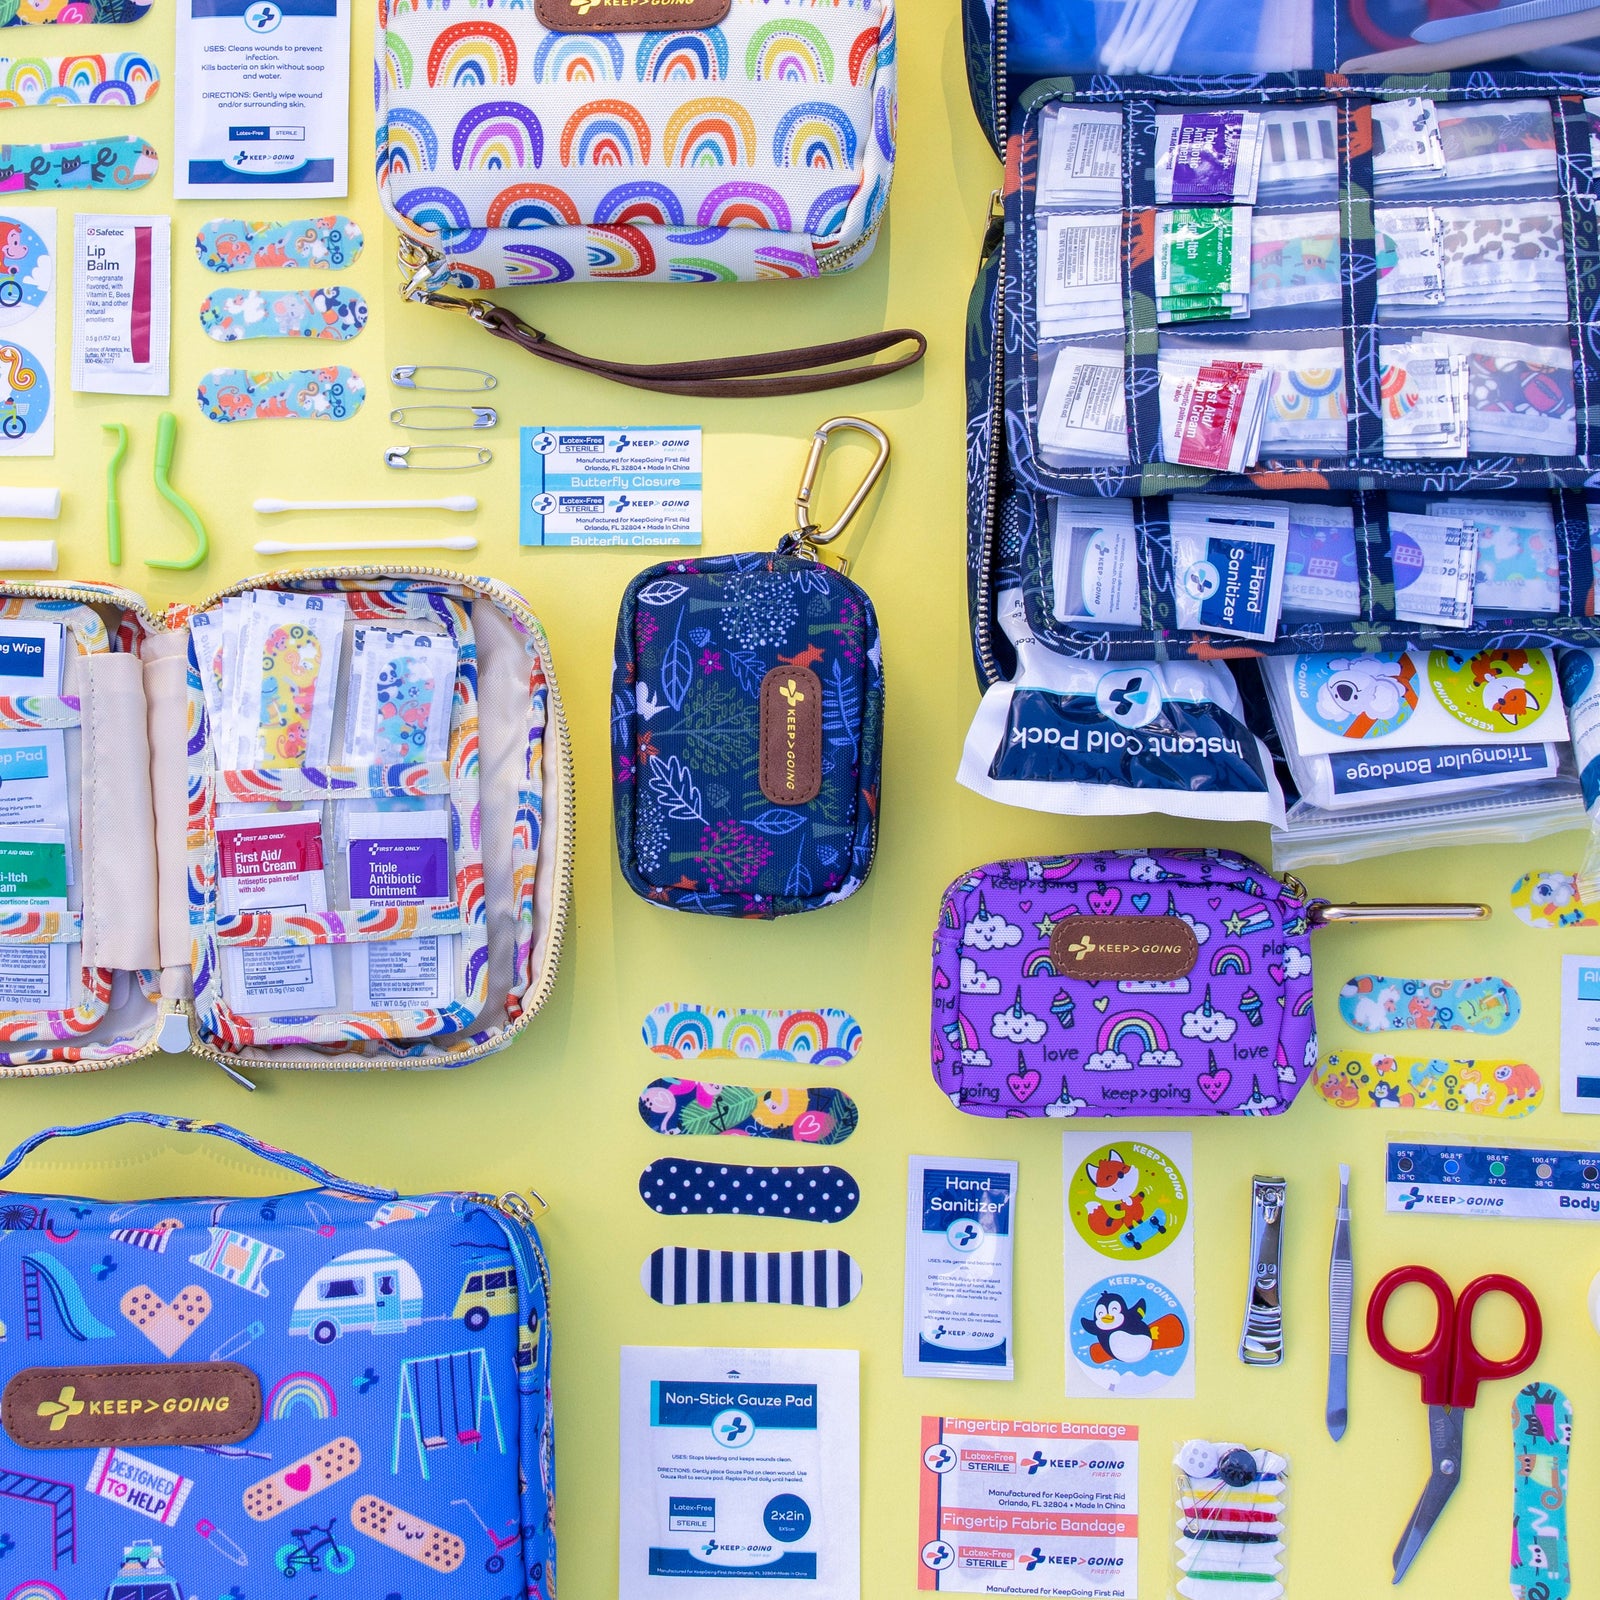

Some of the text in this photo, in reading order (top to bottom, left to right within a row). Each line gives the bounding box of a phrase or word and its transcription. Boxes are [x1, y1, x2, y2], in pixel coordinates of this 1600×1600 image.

[87, 246, 105, 258] Lip
[87, 260, 119, 270] Balm
[1187, 405, 1204, 438] Cream
[1202, 405, 1216, 428] Aid/
[571, 477, 680, 489] Butterfly Closure
[632, 537, 680, 545] Closure
[1222, 548, 1244, 625] Sanitizer
[1246, 566, 1265, 613] Hand
[12, 643, 41, 654] Wipe
[1432, 680, 1494, 732] KEEP>GOING
[786, 710, 795, 790] KEEP>GOING
[1013, 727, 1243, 759] Instant Cold Pack
[16, 749, 43, 762] Pad
[1347, 746, 1532, 781] Triangular Bandage
[235, 849, 282, 863] First Aid/
[236, 861, 296, 874] Burn Cream
[369, 862, 397, 874] Triple
[238, 877, 267, 885] Antiseptic
[370, 874, 421, 884] Antibiotic
[370, 885, 416, 896] Ointment
[1099, 943, 1181, 955] KEEP>GOING
[1043, 1044, 1079, 1061] love
[1233, 1044, 1269, 1060] love
[1102, 1084, 1191, 1102] keep>going
[1133, 1144, 1183, 1200] KEEP>GOING
[946, 1177, 991, 1190] Hand
[931, 1197, 1004, 1213] Sanitizer
[1560, 1196, 1599, 1211] Body
[1108, 1277, 1177, 1308] KEEP>GOING
[90, 1397, 230, 1415] KEEP>GOING
[666, 1392, 813, 1407] Non-Stick Gauze Pad
[945, 1418, 1126, 1437] Fingertip Fabric Bandage
[1435, 1419, 1446, 1448] CHINA
[965, 1451, 1014, 1462] Latex-Free
[968, 1462, 1009, 1472] STERILE
[1050, 1459, 1124, 1470] KEEP>GOING
[108, 1459, 175, 1495] DESIGNED
[107, 1478, 167, 1515] TO HELP
[989, 1489, 1040, 1498] Manufactured
[1055, 1492, 1094, 1501] KeepGoing
[999, 1500, 1030, 1508] Orlando,
[771, 1511, 804, 1521] 2x2in
[943, 1513, 1125, 1534] Fingertip Fabric Bandage
[963, 1548, 1012, 1559] Latex-Free
[966, 1559, 1007, 1568] STERILE
[1049, 1556, 1124, 1566] KEEP>GOING
